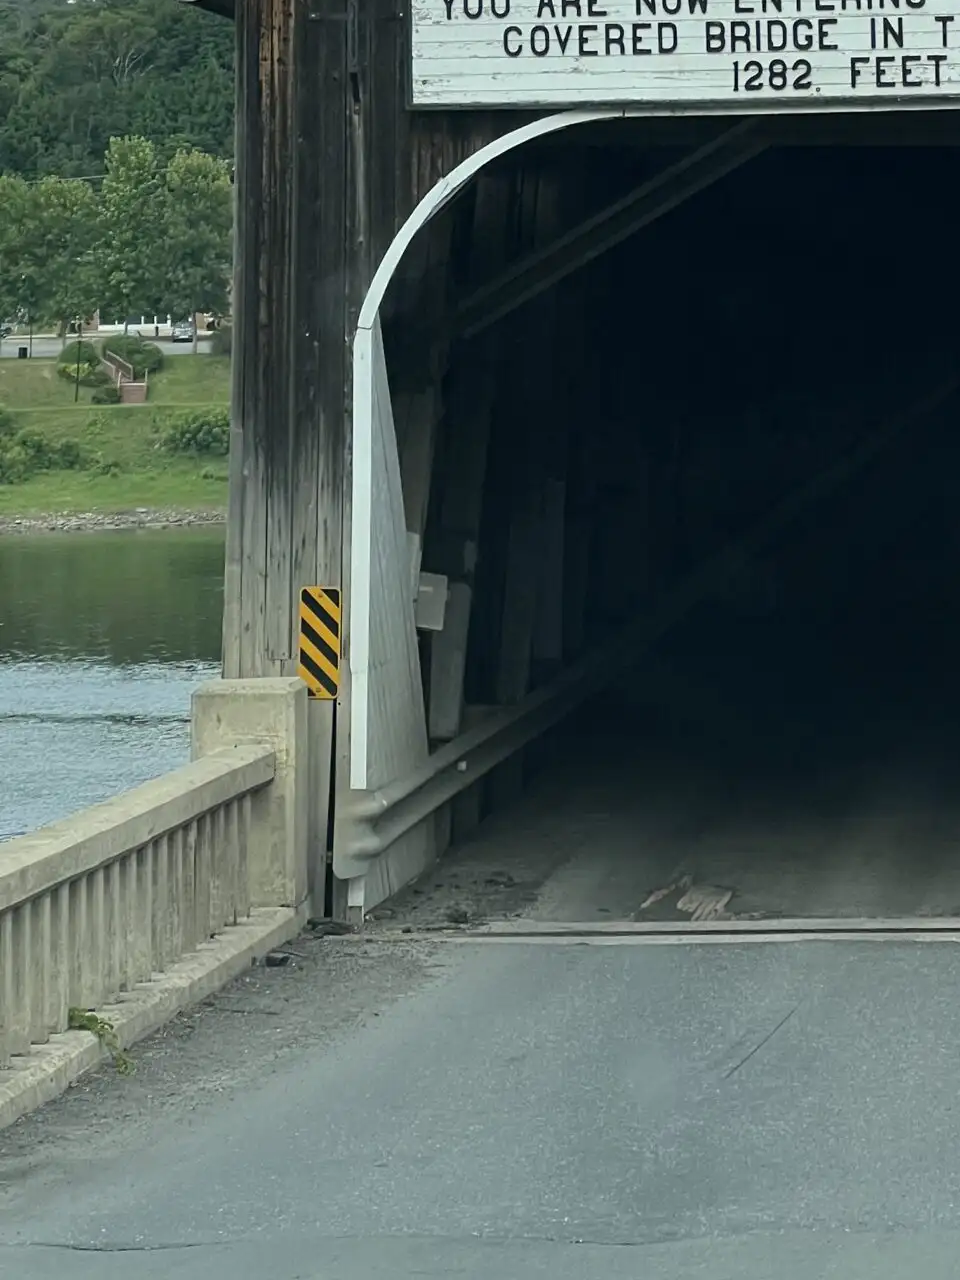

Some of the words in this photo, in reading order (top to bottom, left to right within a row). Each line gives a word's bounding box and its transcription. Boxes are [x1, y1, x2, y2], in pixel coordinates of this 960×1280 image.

[504, 23, 677, 58] COVERED
[706, 19, 838, 53] BRIDGE
[871, 17, 903, 49] IN
[733, 59, 812, 91] 1282
[851, 55, 947, 88] FEET
